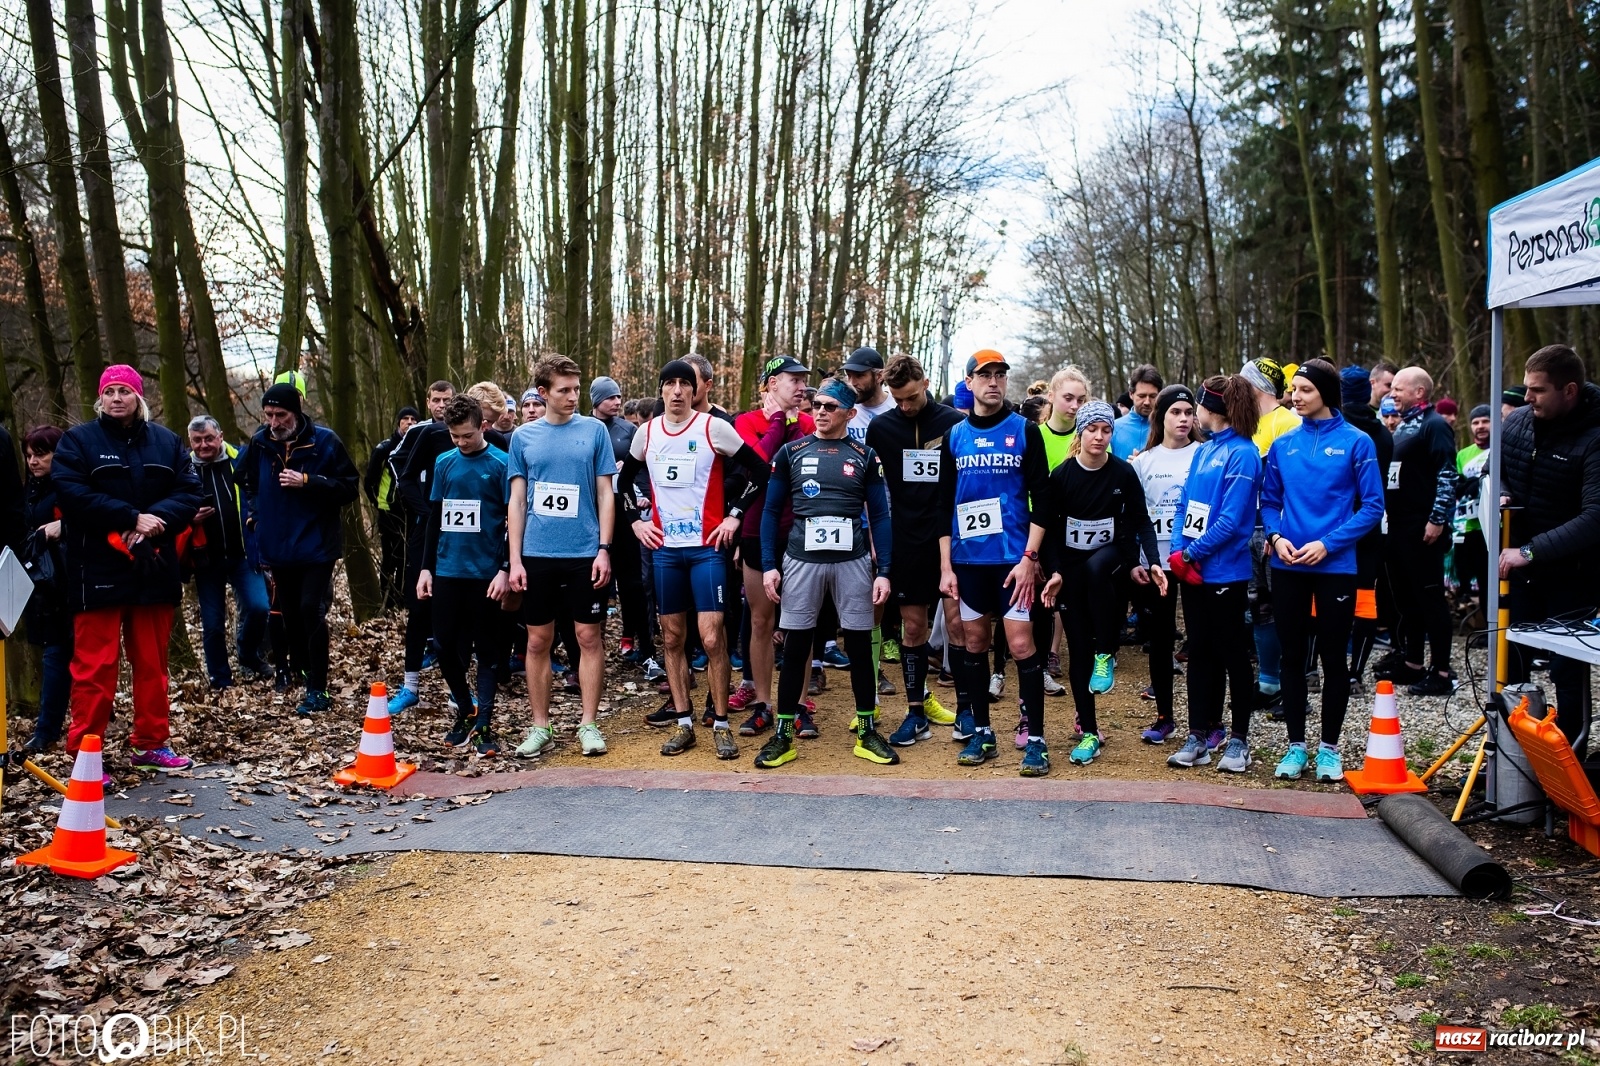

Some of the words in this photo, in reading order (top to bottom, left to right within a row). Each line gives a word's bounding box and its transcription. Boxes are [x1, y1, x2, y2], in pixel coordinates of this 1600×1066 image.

[847, 427, 868, 440] RU
[913, 461, 939, 477] 35
[955, 453, 1023, 471] RUNNERS
[666, 466, 678, 481] 5
[542, 495, 569, 511] 49
[444, 511, 475, 526] 121
[965, 512, 991, 531] 29
[815, 528, 840, 544] 31
[1069, 529, 1111, 545] 173
